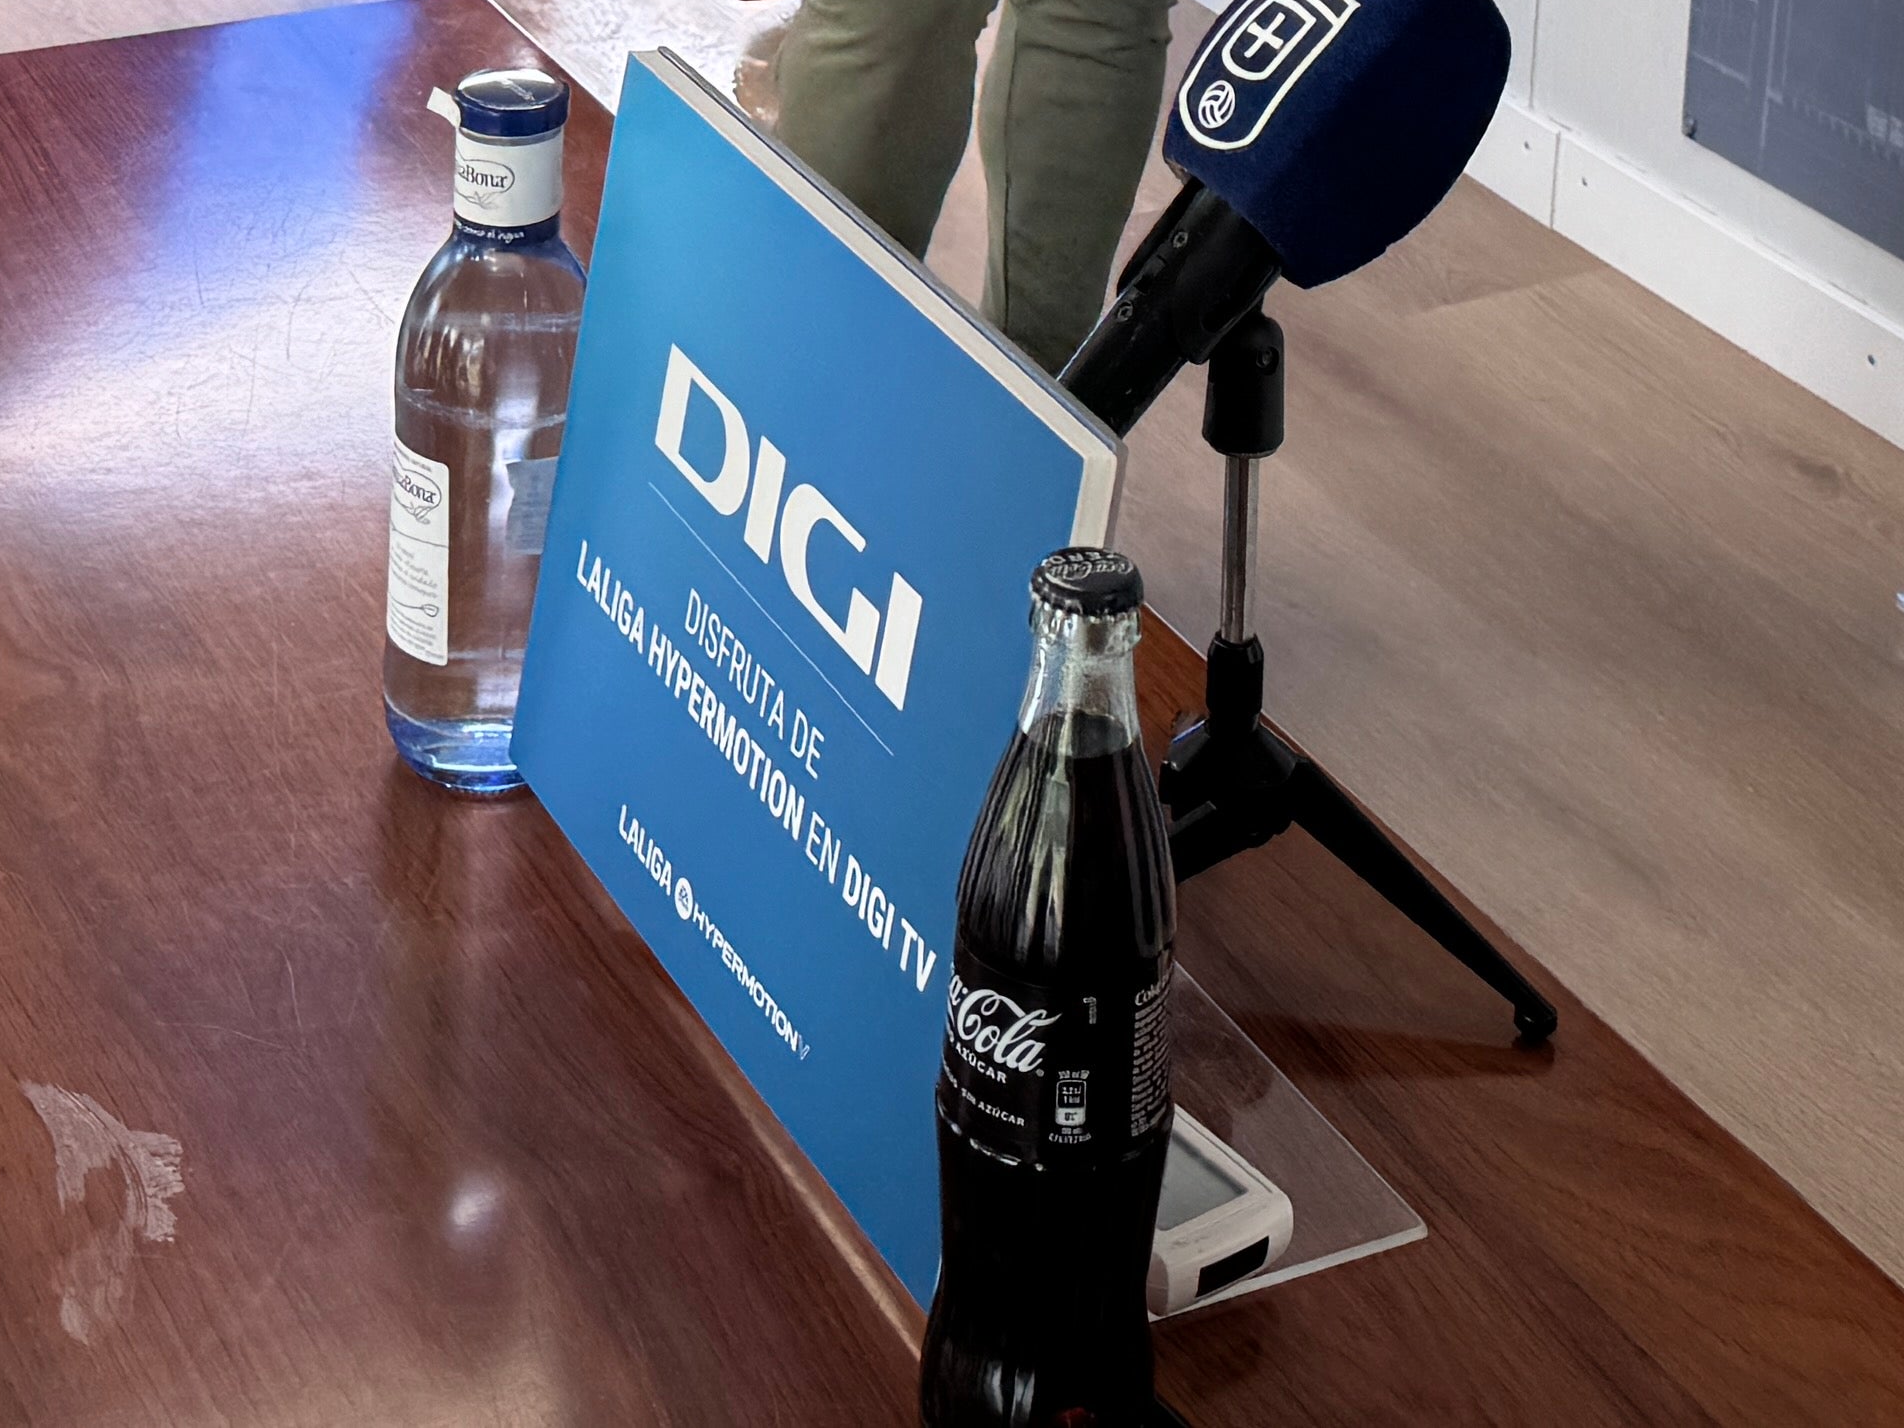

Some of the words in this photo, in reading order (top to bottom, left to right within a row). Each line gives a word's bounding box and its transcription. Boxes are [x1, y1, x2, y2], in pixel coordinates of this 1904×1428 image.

[654, 343, 924, 712] DIGI
[576, 540, 645, 654] LALIGA
[648, 624, 806, 841] HYPERMOTION
[805, 811, 841, 885] EN
[842, 854, 896, 950] DIGI
[899, 917, 937, 993] TV
[684, 588, 785, 740] DISFRUTA
[790, 709, 826, 780] DE
[618, 804, 672, 896] LALIGA
[692, 903, 799, 1052] HYPERMOTION
